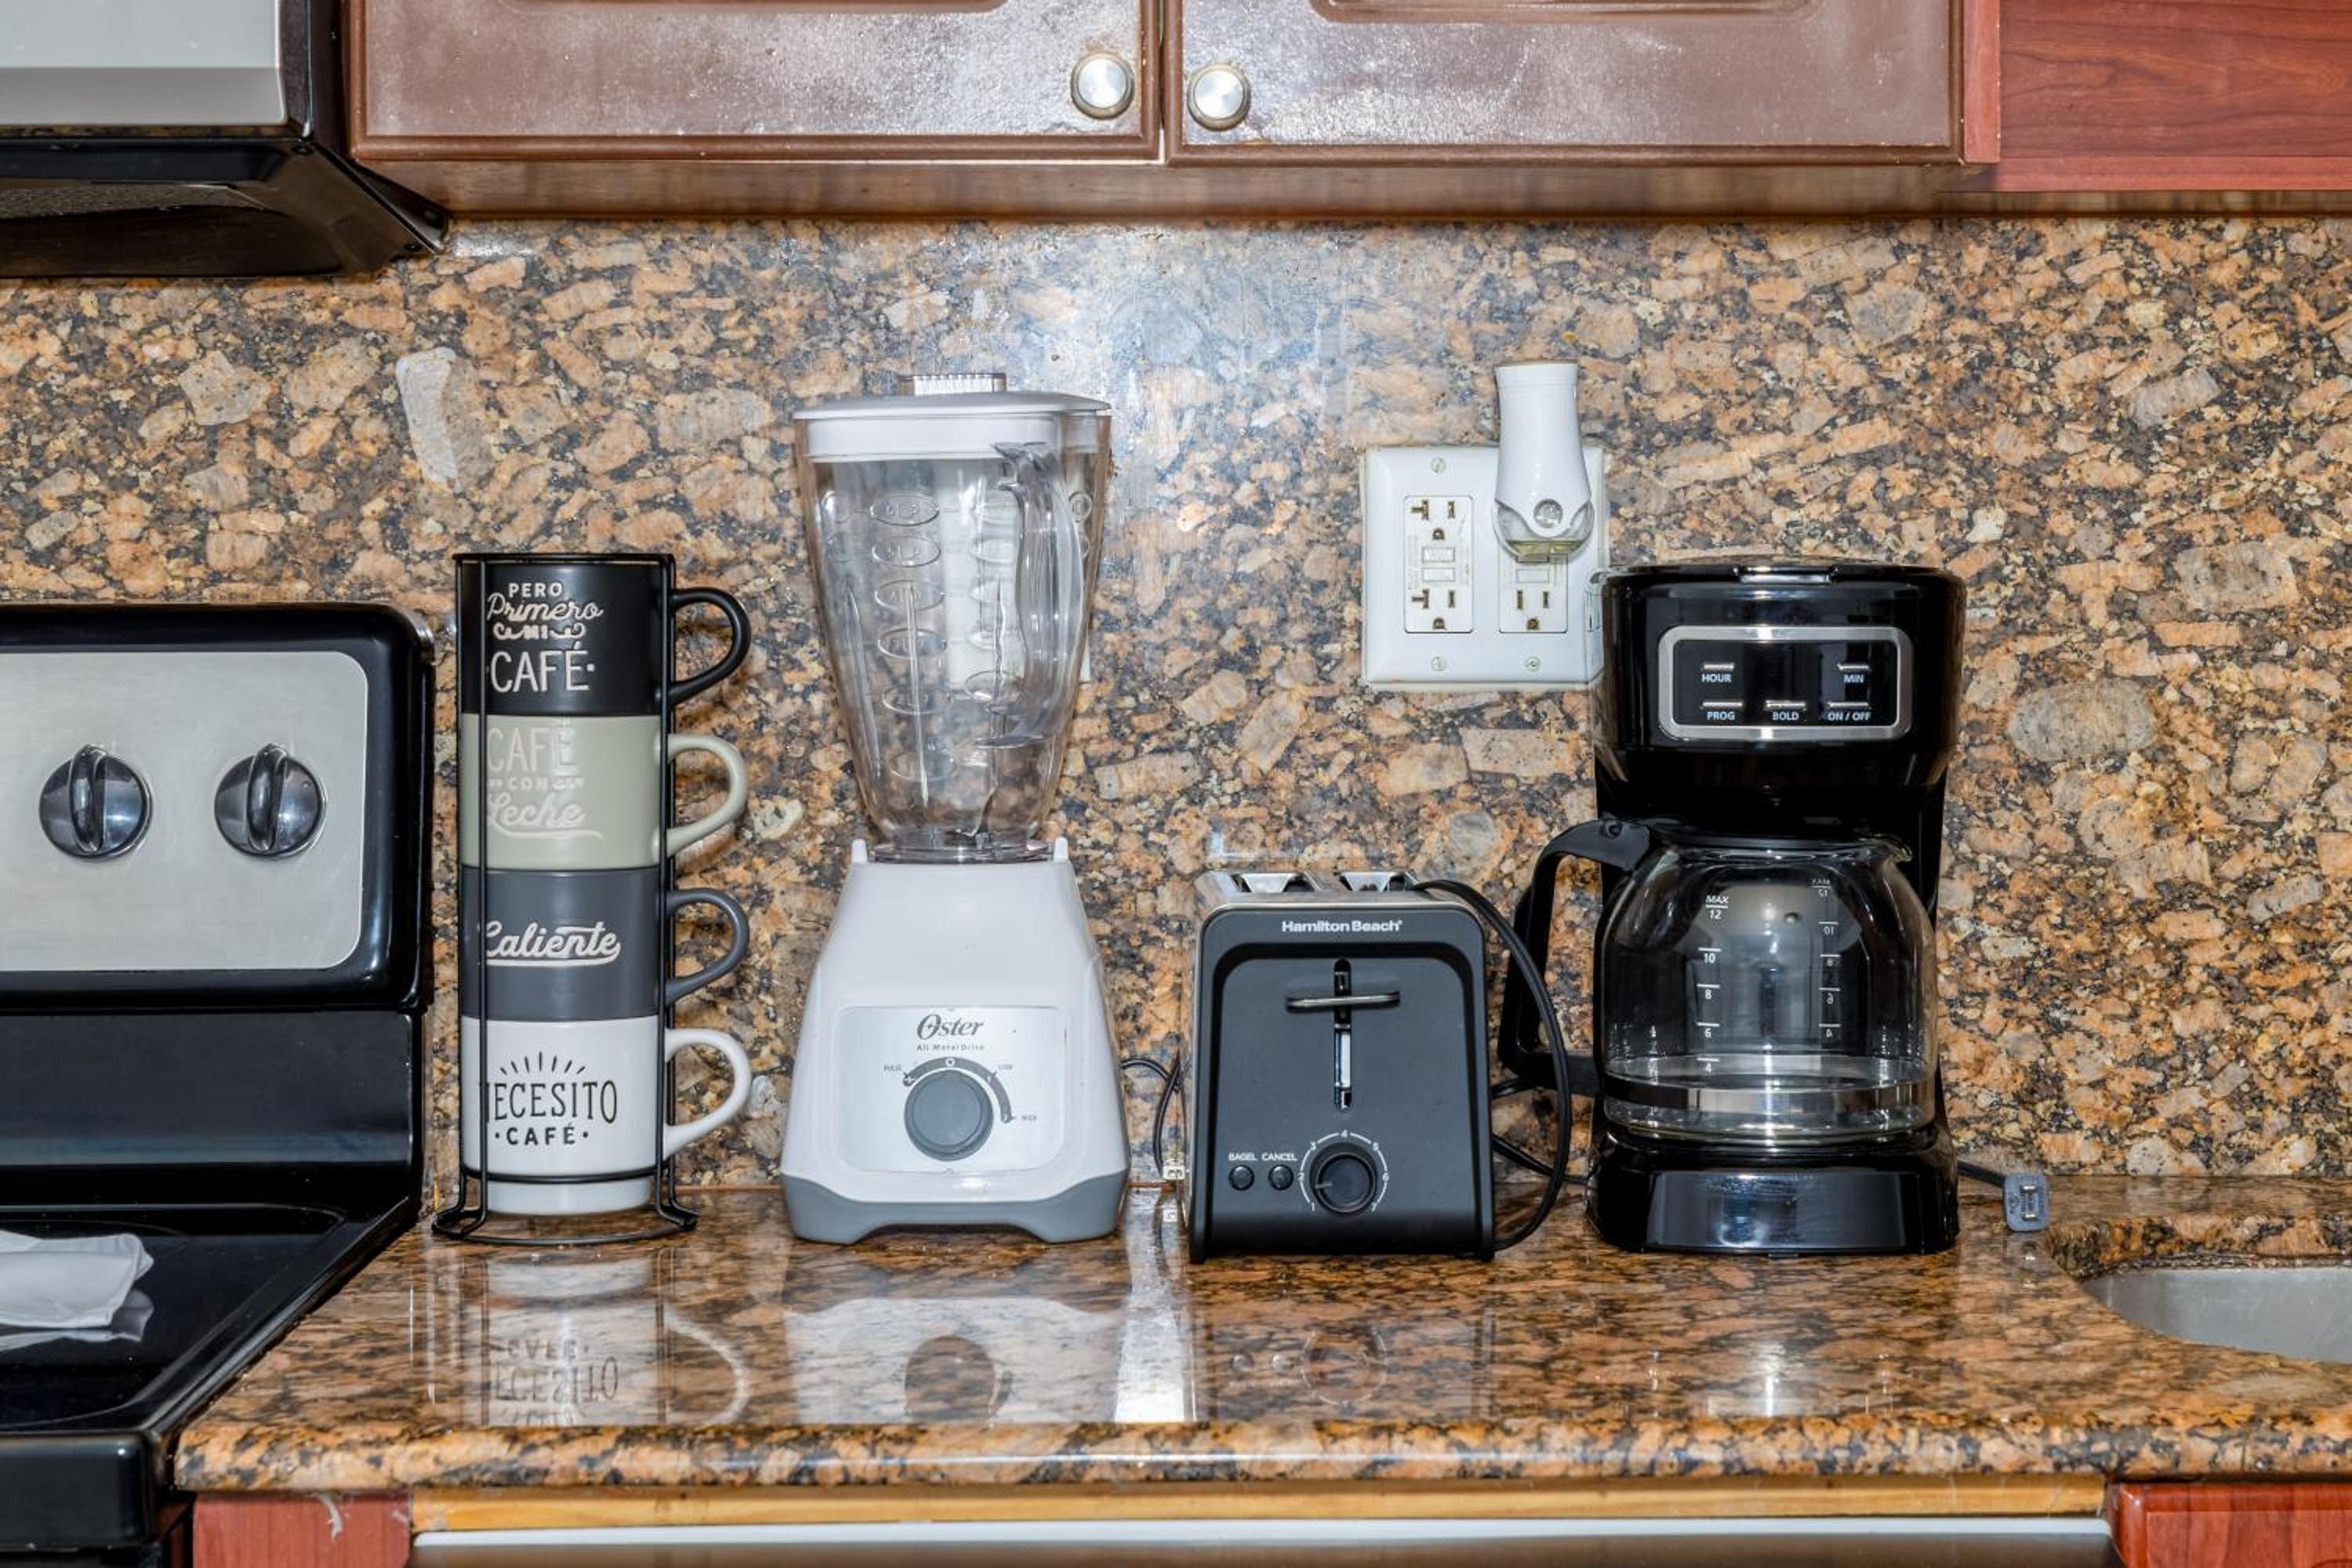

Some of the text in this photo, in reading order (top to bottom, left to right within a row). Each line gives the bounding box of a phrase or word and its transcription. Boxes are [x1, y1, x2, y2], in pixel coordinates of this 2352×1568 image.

[508, 583, 563, 598] PERO
[487, 593, 603, 622] Primero
[489, 641, 590, 693] CAFÉ
[1701, 673, 1732, 683] HOUR
[1843, 673, 1864, 683] MIN
[1706, 711, 1735, 720] PROG
[1772, 711, 1799, 720] BOLD
[1828, 711, 1844, 720] ON
[1853, 711, 1871, 720] OFF
[487, 790, 588, 833] Leche
[1705, 895, 1730, 905] MAX
[1709, 909, 1722, 920] 12
[1282, 920, 1350, 932] Hamilton
[476, 920, 622, 966] Caliente
[1703, 953, 1716, 964] 10
[1704, 989, 1712, 1000] 8
[916, 1014, 984, 1040] Oster
[1705, 1063, 1712, 1073] 4
[506, 1123, 575, 1146] CAFÉ
[1341, 1129, 1348, 1138] 4
[1310, 1142, 1317, 1150] 3
[1373, 1142, 1379, 1151] 5
[1229, 1152, 1258, 1161] BAGEL
[1261, 1152, 1298, 1161] CANCEL
[1311, 1203, 1316, 1211] 1
